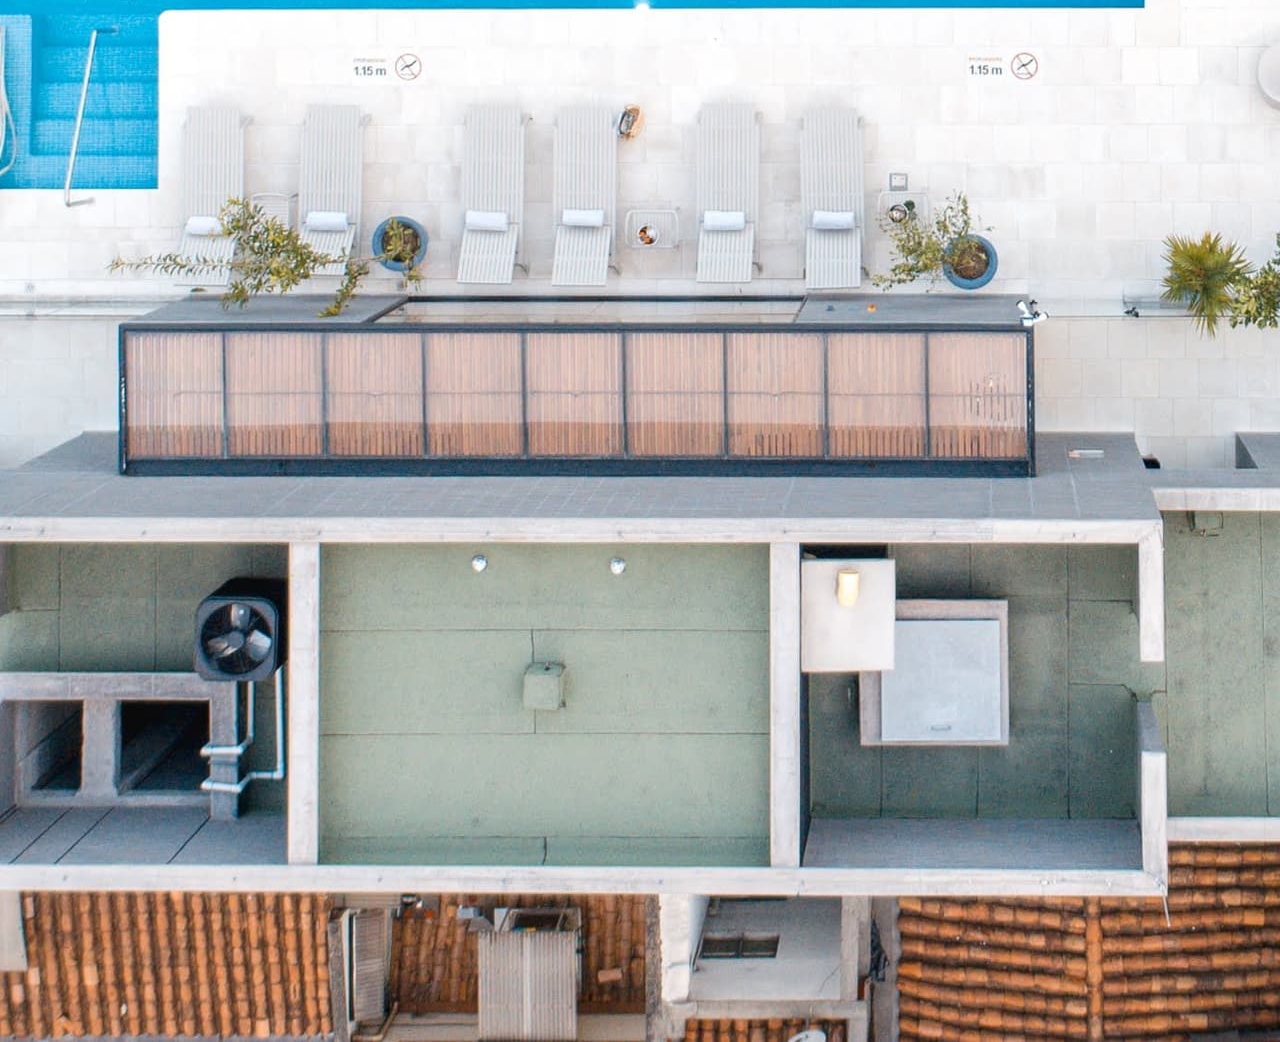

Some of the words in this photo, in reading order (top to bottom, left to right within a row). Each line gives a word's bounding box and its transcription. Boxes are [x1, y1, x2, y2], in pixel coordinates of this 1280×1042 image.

[354, 65, 373, 76] 1.15
[375, 67, 387, 76] m
[969, 64, 989, 75] 1.15
[991, 66, 1003, 75] m
